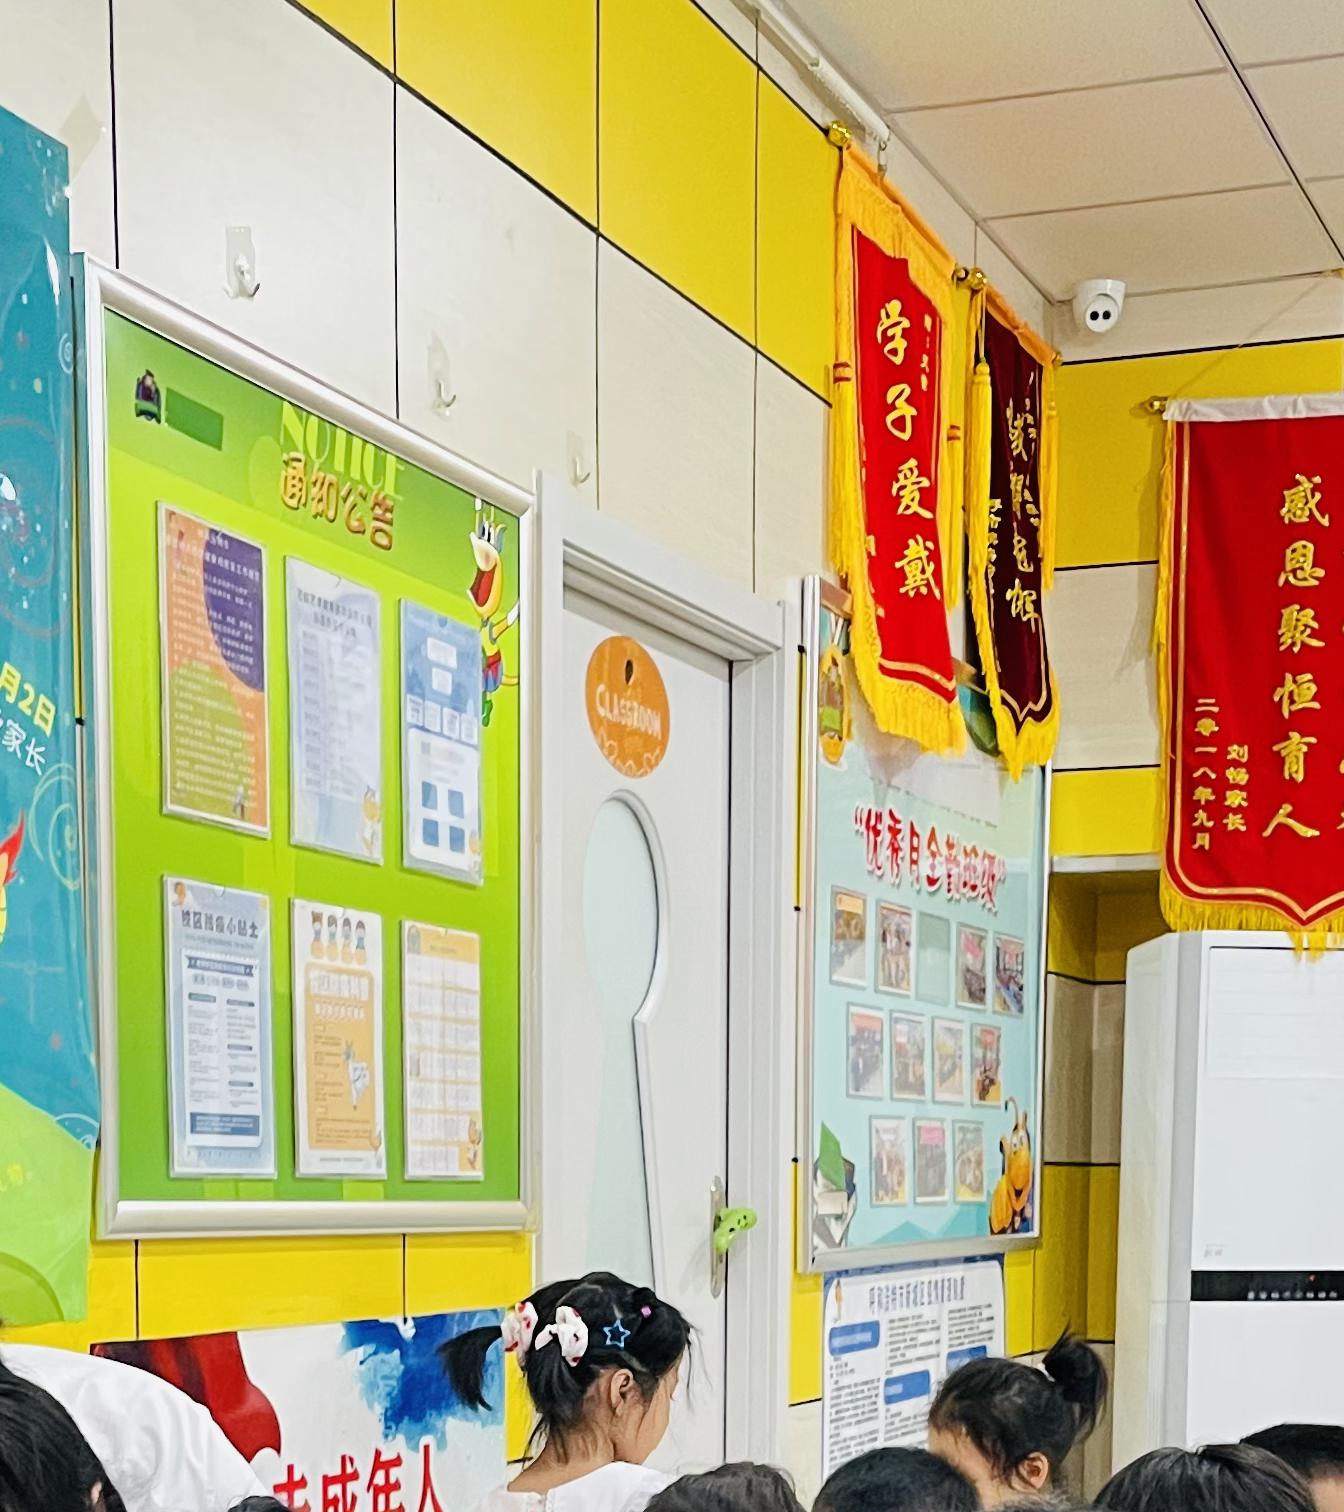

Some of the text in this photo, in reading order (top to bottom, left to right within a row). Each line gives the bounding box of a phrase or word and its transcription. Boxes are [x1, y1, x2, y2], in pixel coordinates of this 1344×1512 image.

[281, 451, 394, 551] 通知公告
[876, 299, 941, 600] 学子爱戴
[1261, 473, 1330, 839] 感恩聚恒育人
